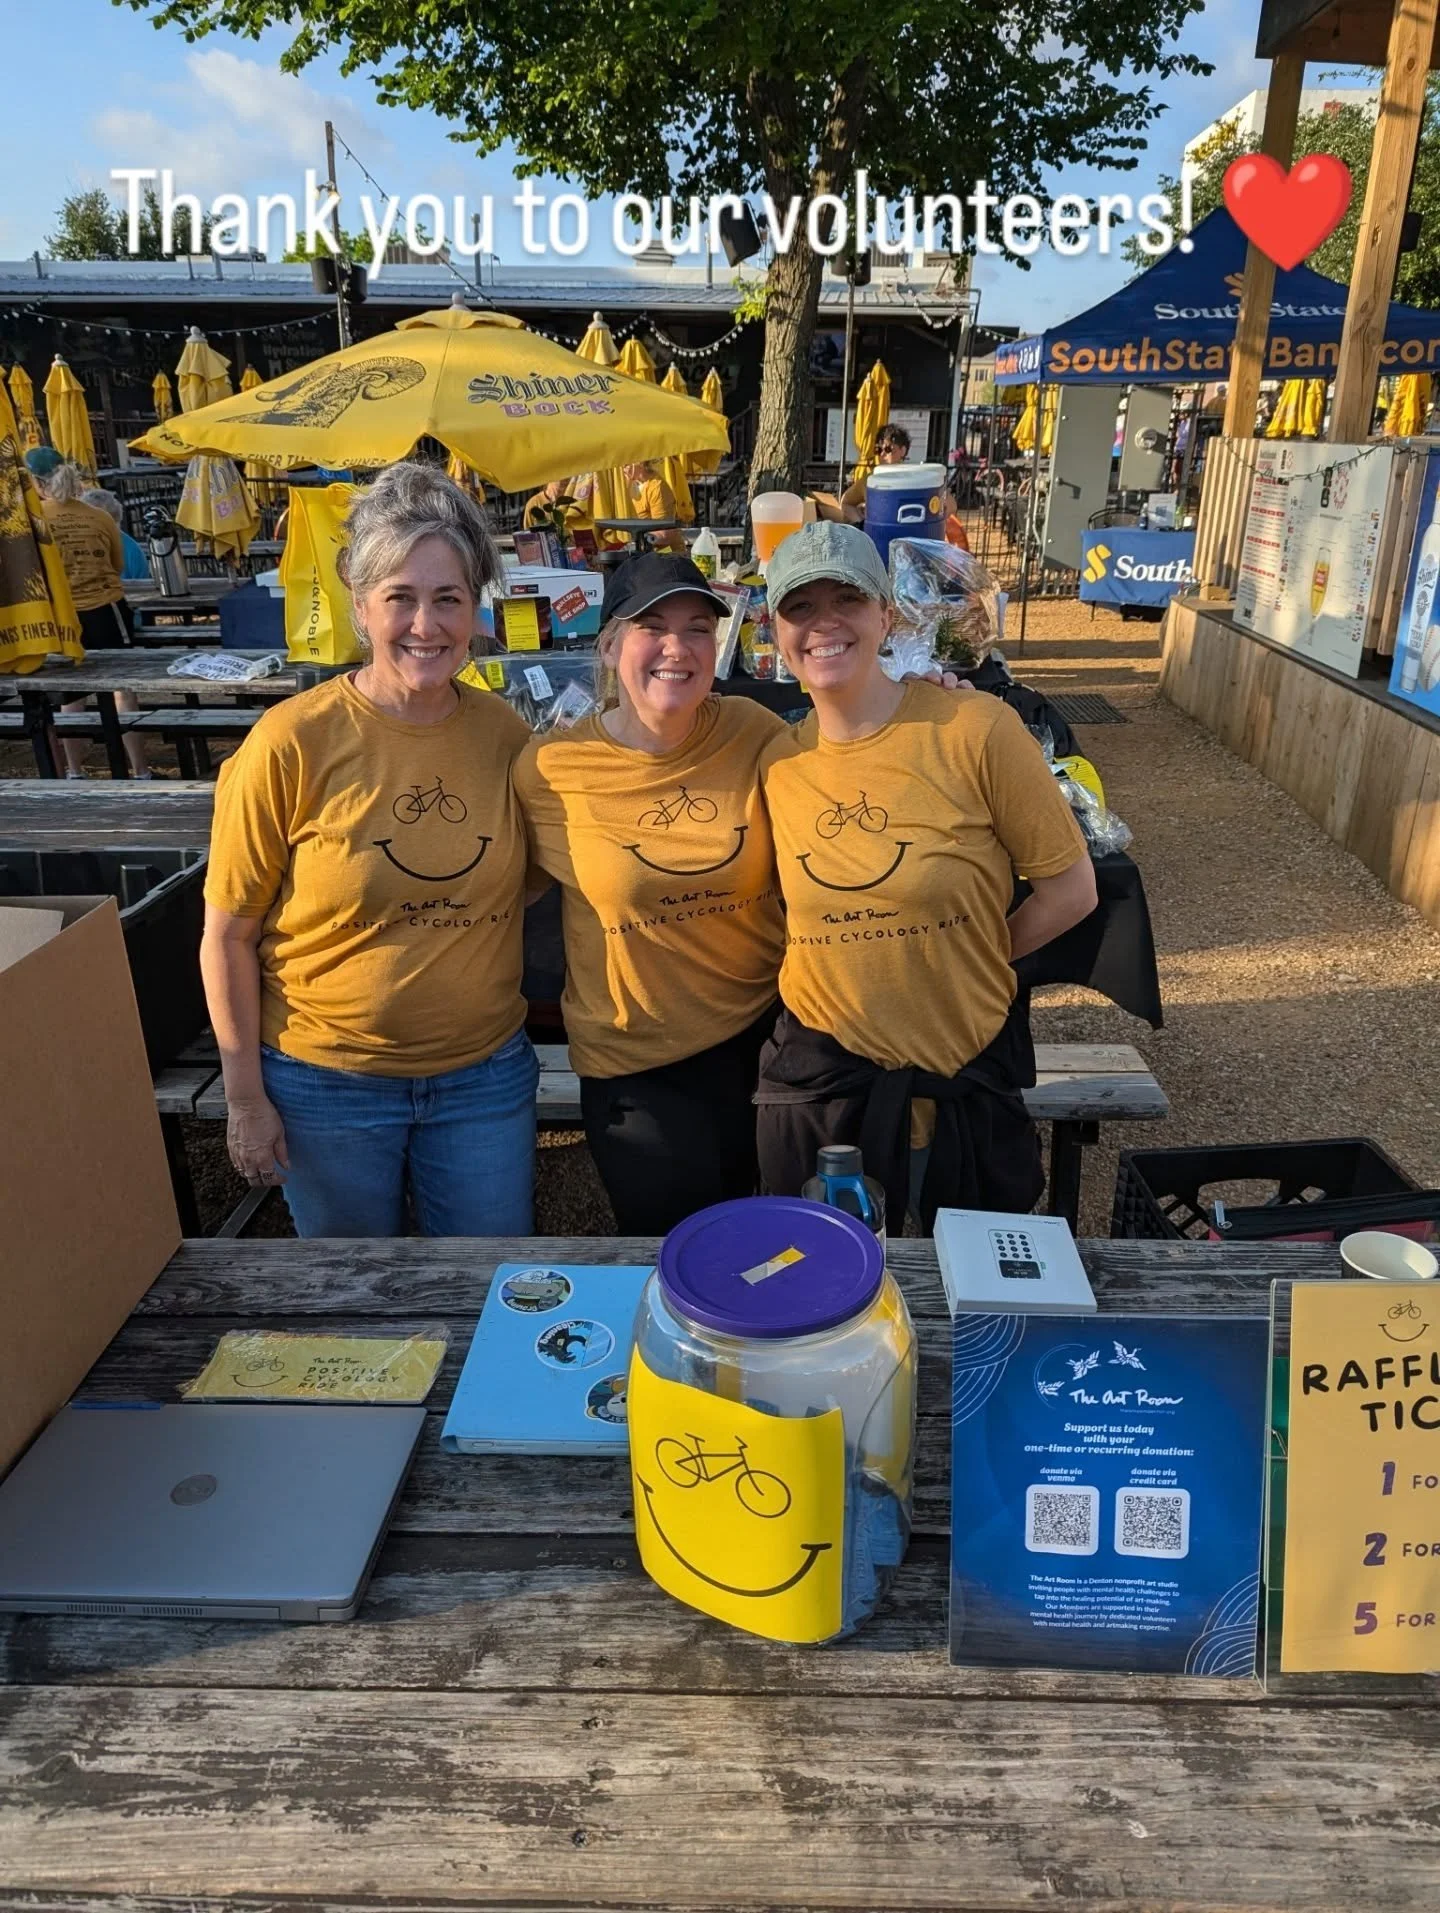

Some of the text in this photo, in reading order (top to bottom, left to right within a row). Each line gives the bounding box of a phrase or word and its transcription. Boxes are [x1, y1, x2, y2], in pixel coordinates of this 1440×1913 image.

[1154, 303, 1347, 320] SoutState
[468, 372, 622, 403] Shiner
[501, 400, 615, 418] BOCK
[21, 620, 56, 641] FINER
[400, 898, 472, 912] The Art Room
[659, 890, 736, 906] The Art Room
[676, 898, 752, 922] CYCOLOGY
[822, 908, 900, 925] The Art Room
[409, 917, 485, 928] CYCOLO
[840, 925, 930, 943] CYCOLOGY
[939, 914, 971, 930] RIDE
[507, 1299, 538, 1312] Drawing
[540, 1321, 576, 1344] Cleaning
[307, 1367, 389, 1375] POSITIVE
[1069, 1389, 1184, 1406] The Art Room
[1360, 1396, 1440, 1432] TIC
[1064, 1423, 1155, 1436] Support us today
[1084, 1435, 1135, 1445] with your
[1024, 1444, 1072, 1453] one-time
[1088, 1446, 1141, 1456] recurring
[1142, 1447, 1195, 1456] donation:
[1040, 1467, 1068, 1475] donate
[1131, 1467, 1161, 1476] donate
[1382, 1461, 1396, 1496] 1
[1363, 1532, 1440, 1566] 2 FOR
[1353, 1602, 1436, 1635] 5 FOR
